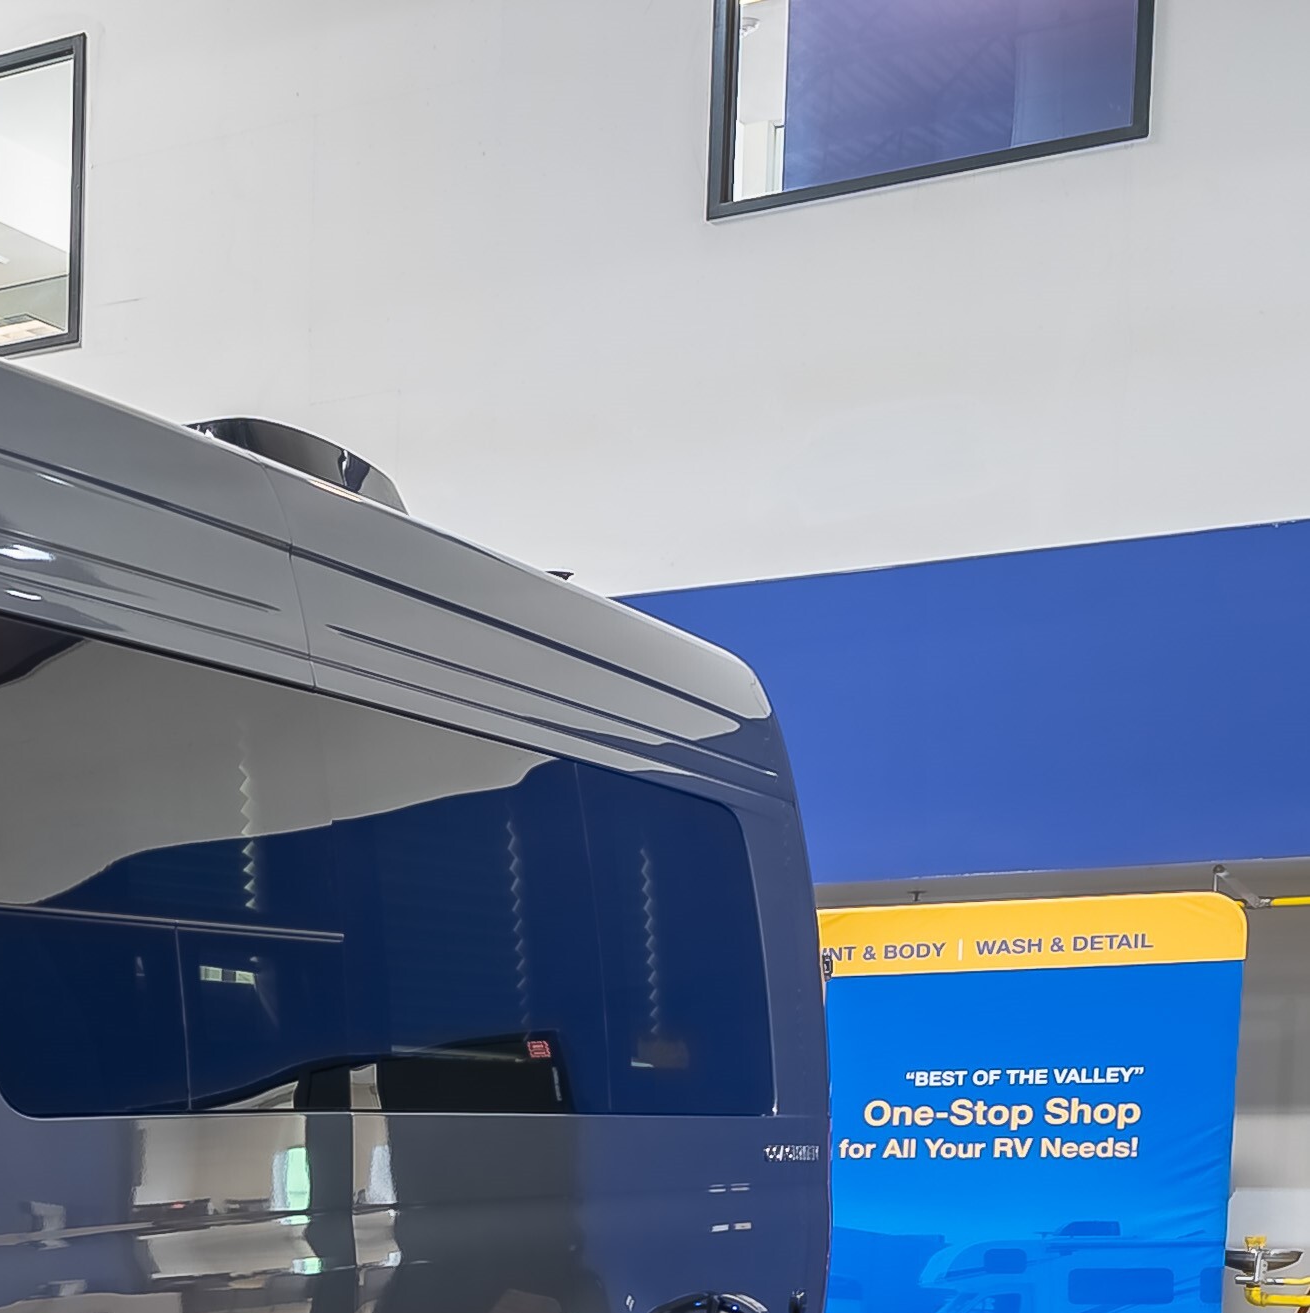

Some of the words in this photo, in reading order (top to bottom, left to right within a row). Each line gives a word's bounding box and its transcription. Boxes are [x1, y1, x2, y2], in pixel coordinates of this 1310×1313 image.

[863, 945, 876, 961] &
[884, 942, 946, 960] BODY
[976, 938, 1042, 955] WASH
[1050, 937, 1065, 952] &
[1073, 933, 1154, 951] DETAIL
[973, 1069, 1002, 1086] OF
[1006, 1068, 1048, 1085] THE
[863, 1099, 1034, 1131] One-Stop
[1044, 1097, 1142, 1130] Shop
[839, 1138, 877, 1159] for
[882, 1138, 917, 1159] All
[924, 1138, 986, 1159] Your
[993, 1137, 1034, 1158] RV
[1040, 1136, 1139, 1158] Needs!
